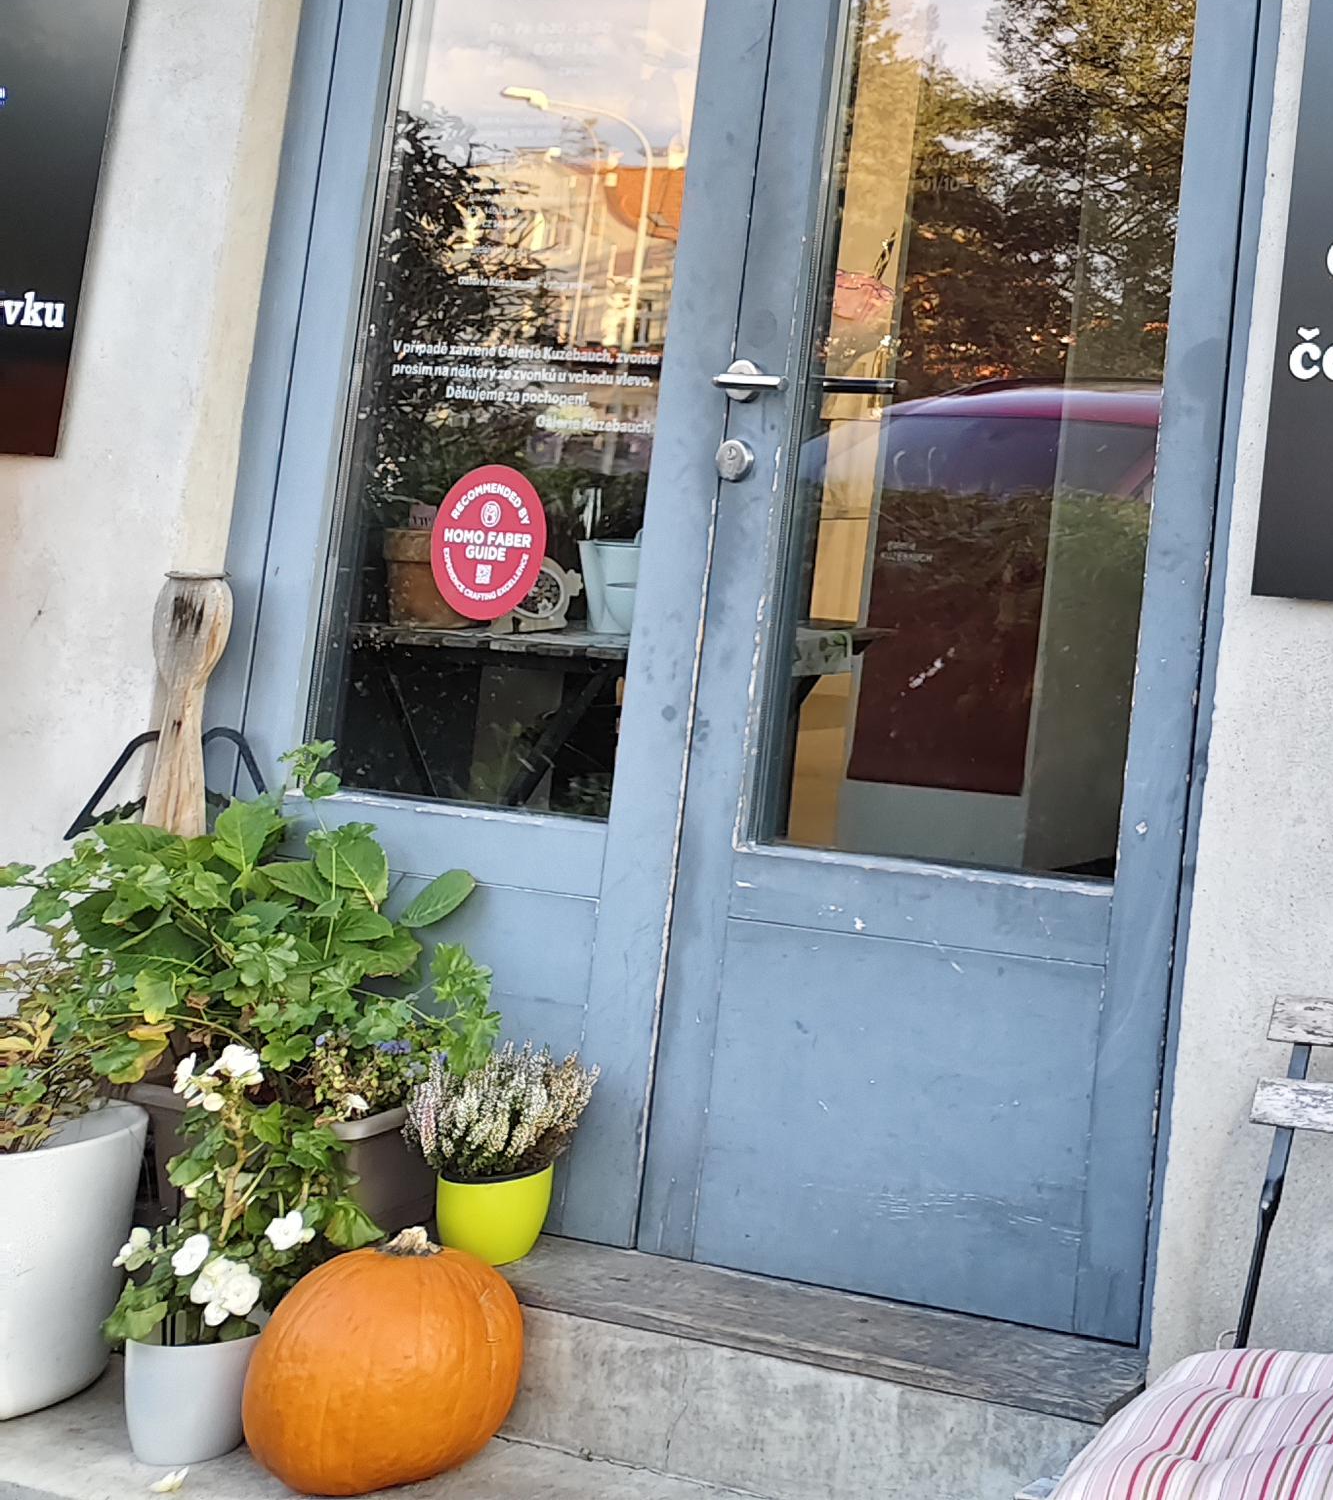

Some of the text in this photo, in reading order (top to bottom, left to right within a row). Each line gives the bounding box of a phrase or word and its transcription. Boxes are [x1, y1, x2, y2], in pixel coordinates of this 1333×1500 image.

[0, 291, 65, 328] vku
[393, 340, 402, 353] V
[403, 340, 448, 356] případě
[498, 345, 540, 359] Galerie
[392, 362, 432, 376] prosím
[434, 366, 448, 377] na
[450, 363, 496, 380] některý
[497, 369, 512, 380] ze
[568, 369, 614, 385] vchodu
[446, 385, 504, 402] Děkujeme
[506, 391, 519, 402] za
[450, 483, 531, 525] RECOMMENDED BY
[443, 528, 532, 548] HOMO FABER
[465, 545, 507, 561] GUIDE
[443, 547, 529, 601] EXPERIENCE CRAFTING EXCELLENCE
